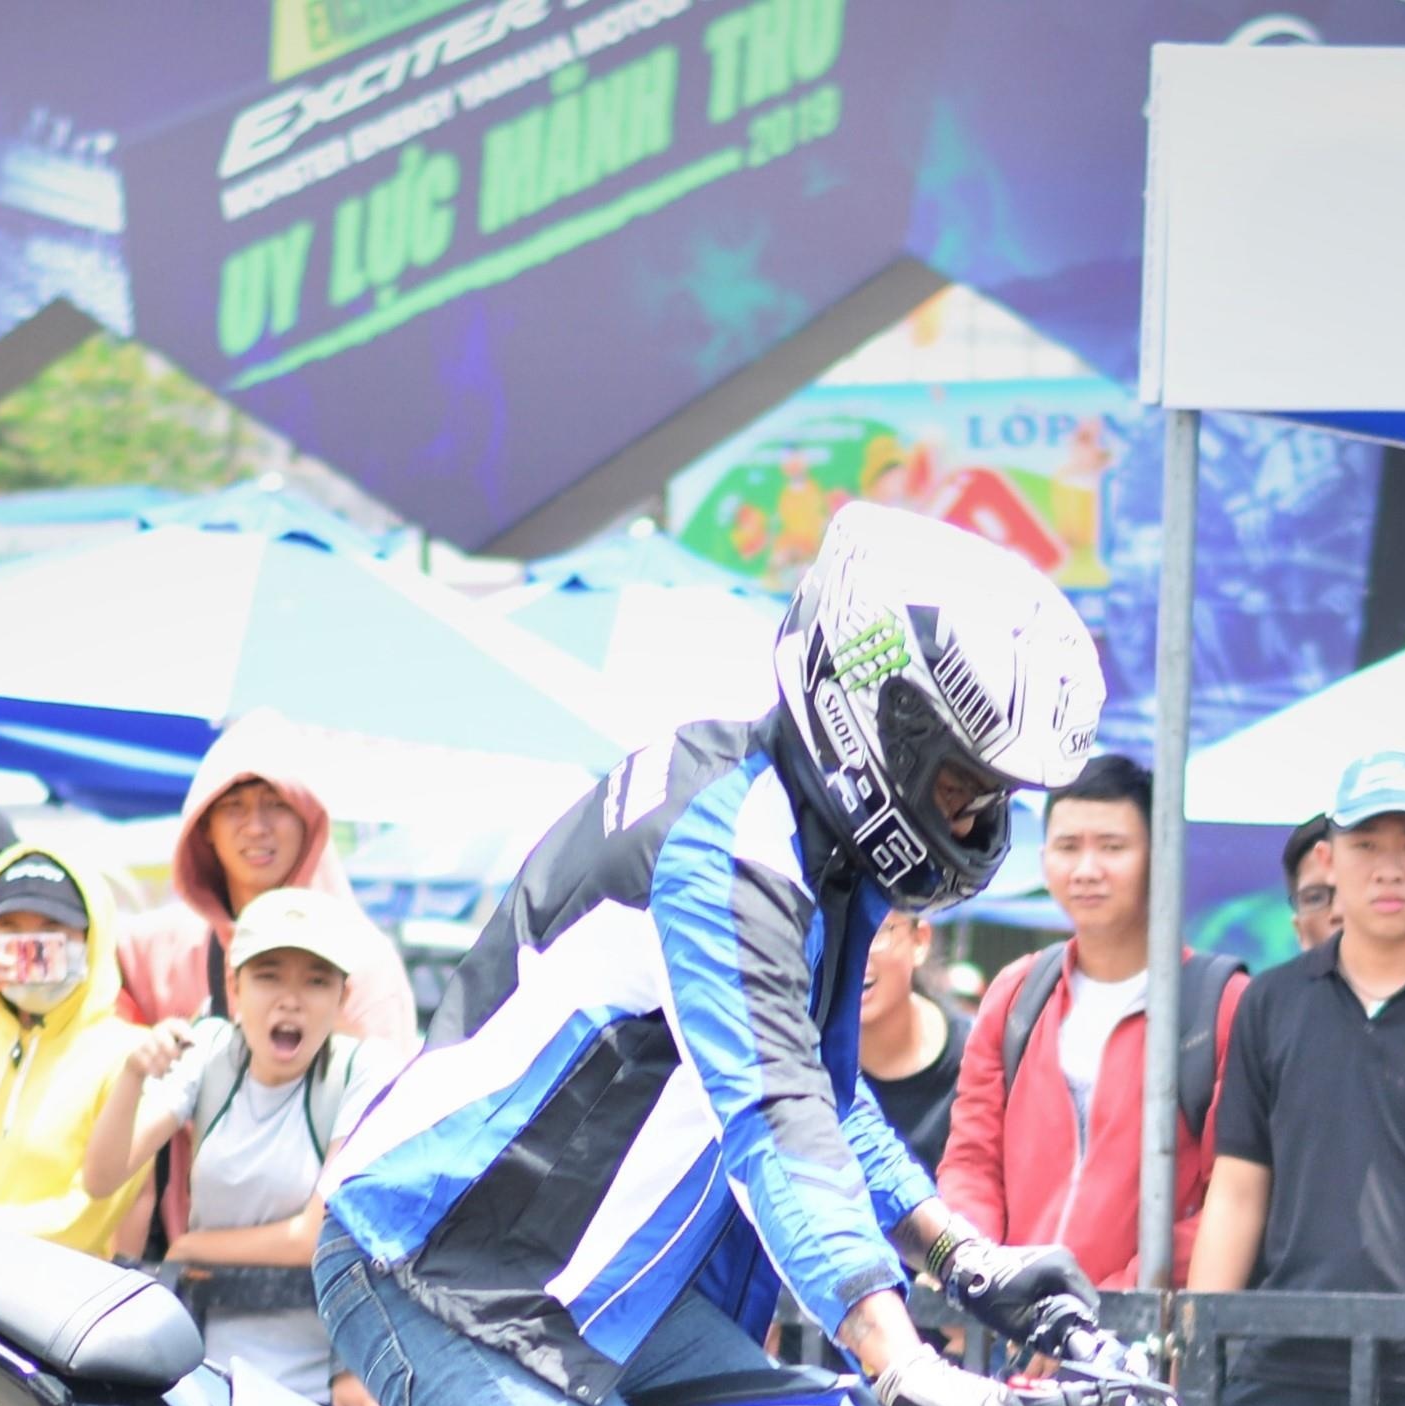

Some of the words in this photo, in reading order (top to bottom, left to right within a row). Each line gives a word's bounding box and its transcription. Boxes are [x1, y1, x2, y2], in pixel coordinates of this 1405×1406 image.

[746, 84, 841, 169] 2019
[219, 222, 313, 357] UY
[822, 693, 859, 756] SHOEI
[1068, 728, 1096, 754] SHO
